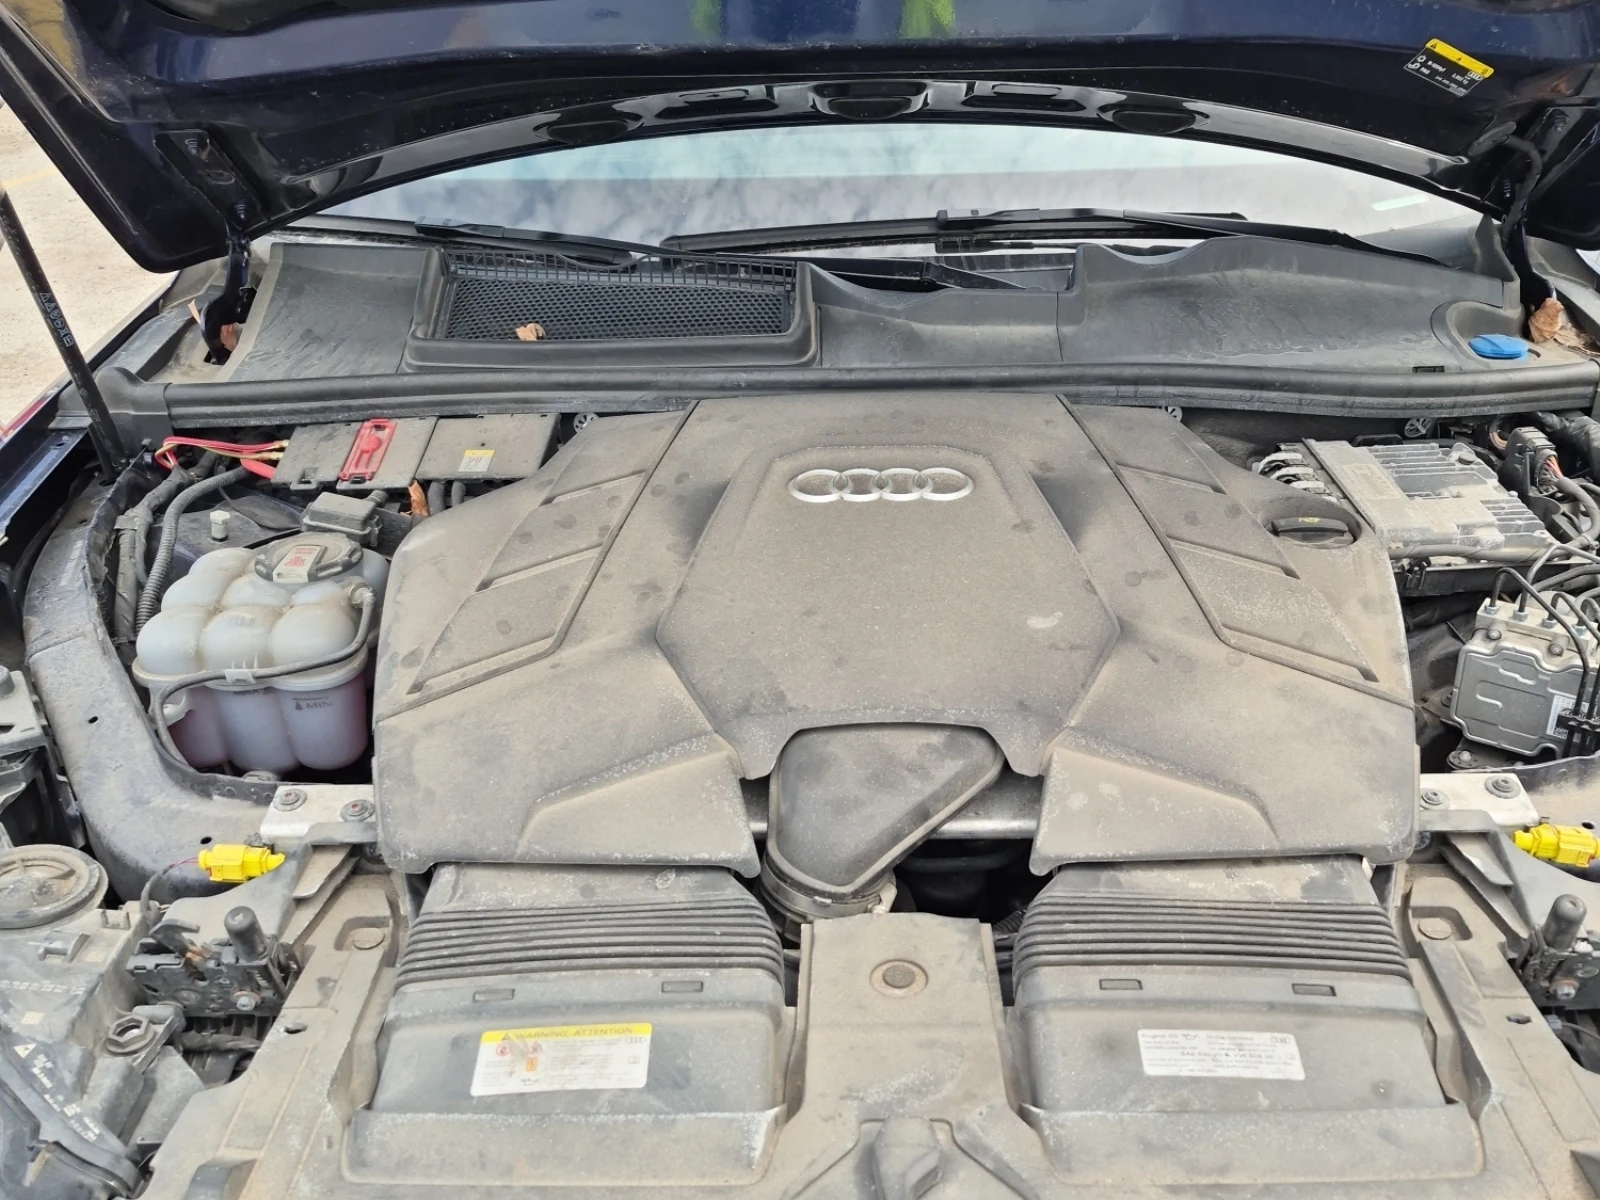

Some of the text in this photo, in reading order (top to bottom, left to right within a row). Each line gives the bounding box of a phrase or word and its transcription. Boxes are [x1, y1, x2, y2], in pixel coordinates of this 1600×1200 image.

[305, 701, 333, 709] MIN
[515, 1027, 633, 1039] WARNING ATTENTION
